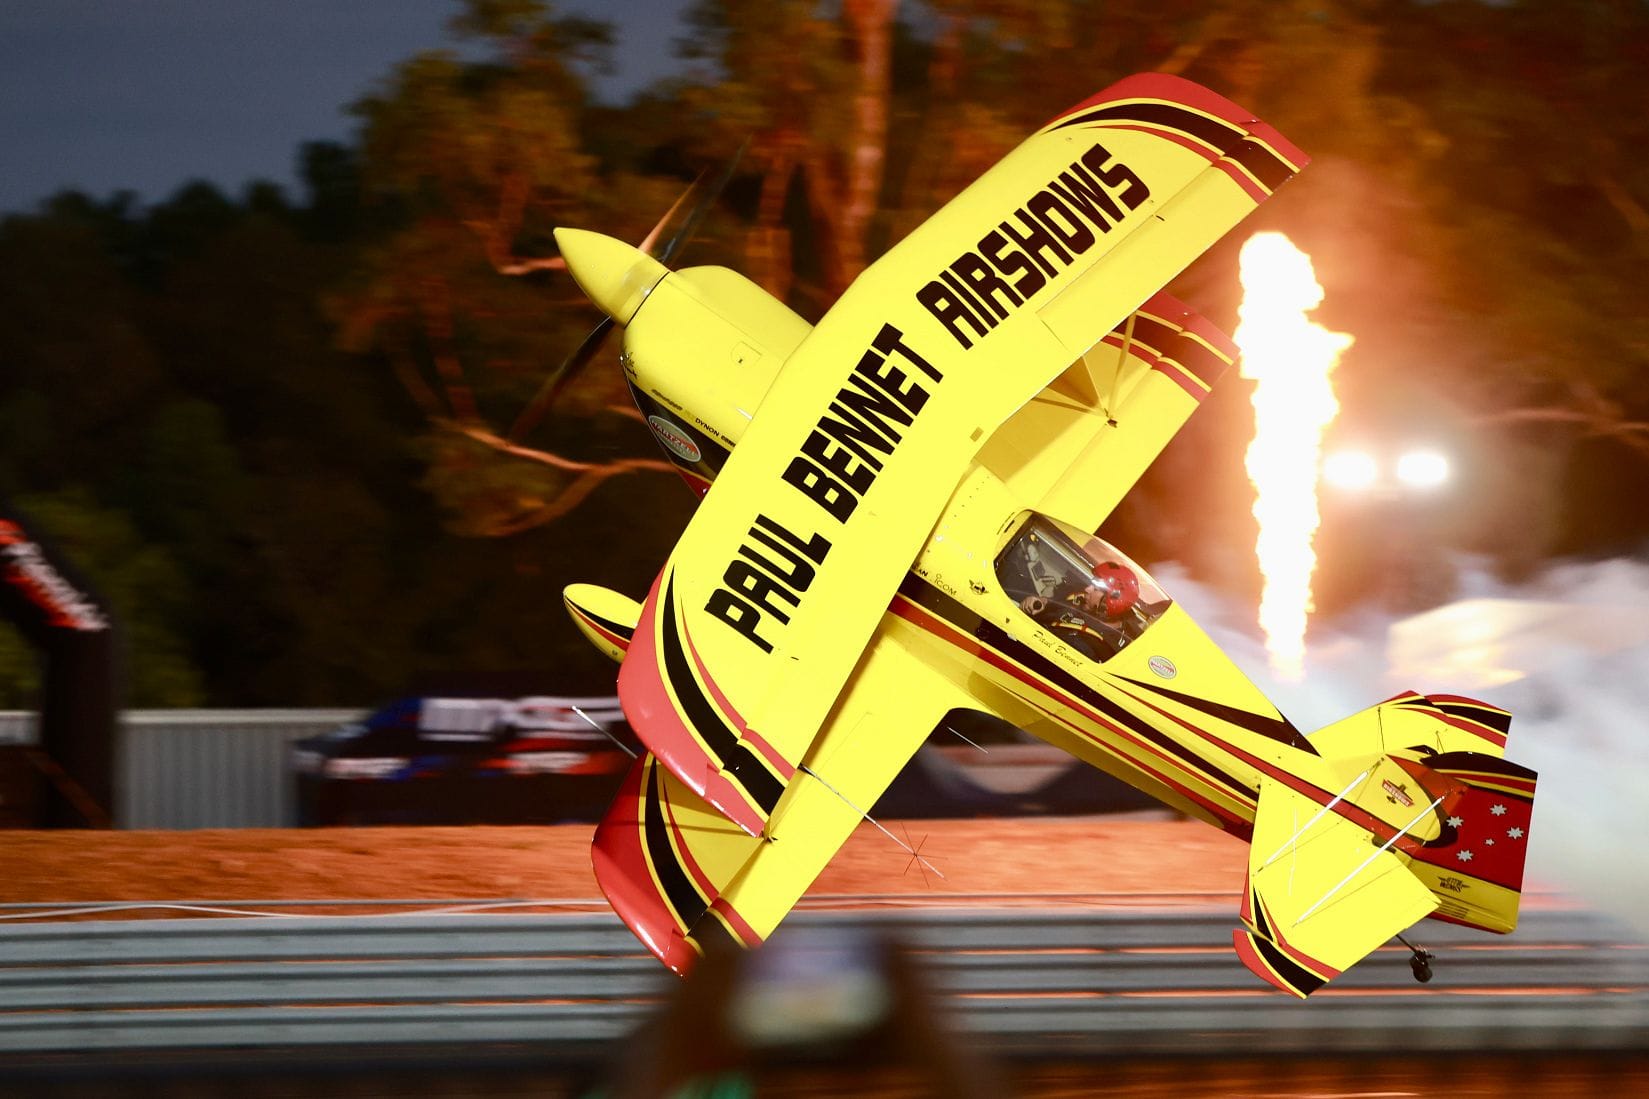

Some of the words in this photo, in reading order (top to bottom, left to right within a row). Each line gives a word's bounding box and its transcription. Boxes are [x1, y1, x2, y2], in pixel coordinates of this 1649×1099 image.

[695, 417, 720, 437] DYNON
[703, 513, 833, 654] PAUL
[781, 322, 944, 525] BENNET
[915, 143, 1150, 350] AIRSHOWS
